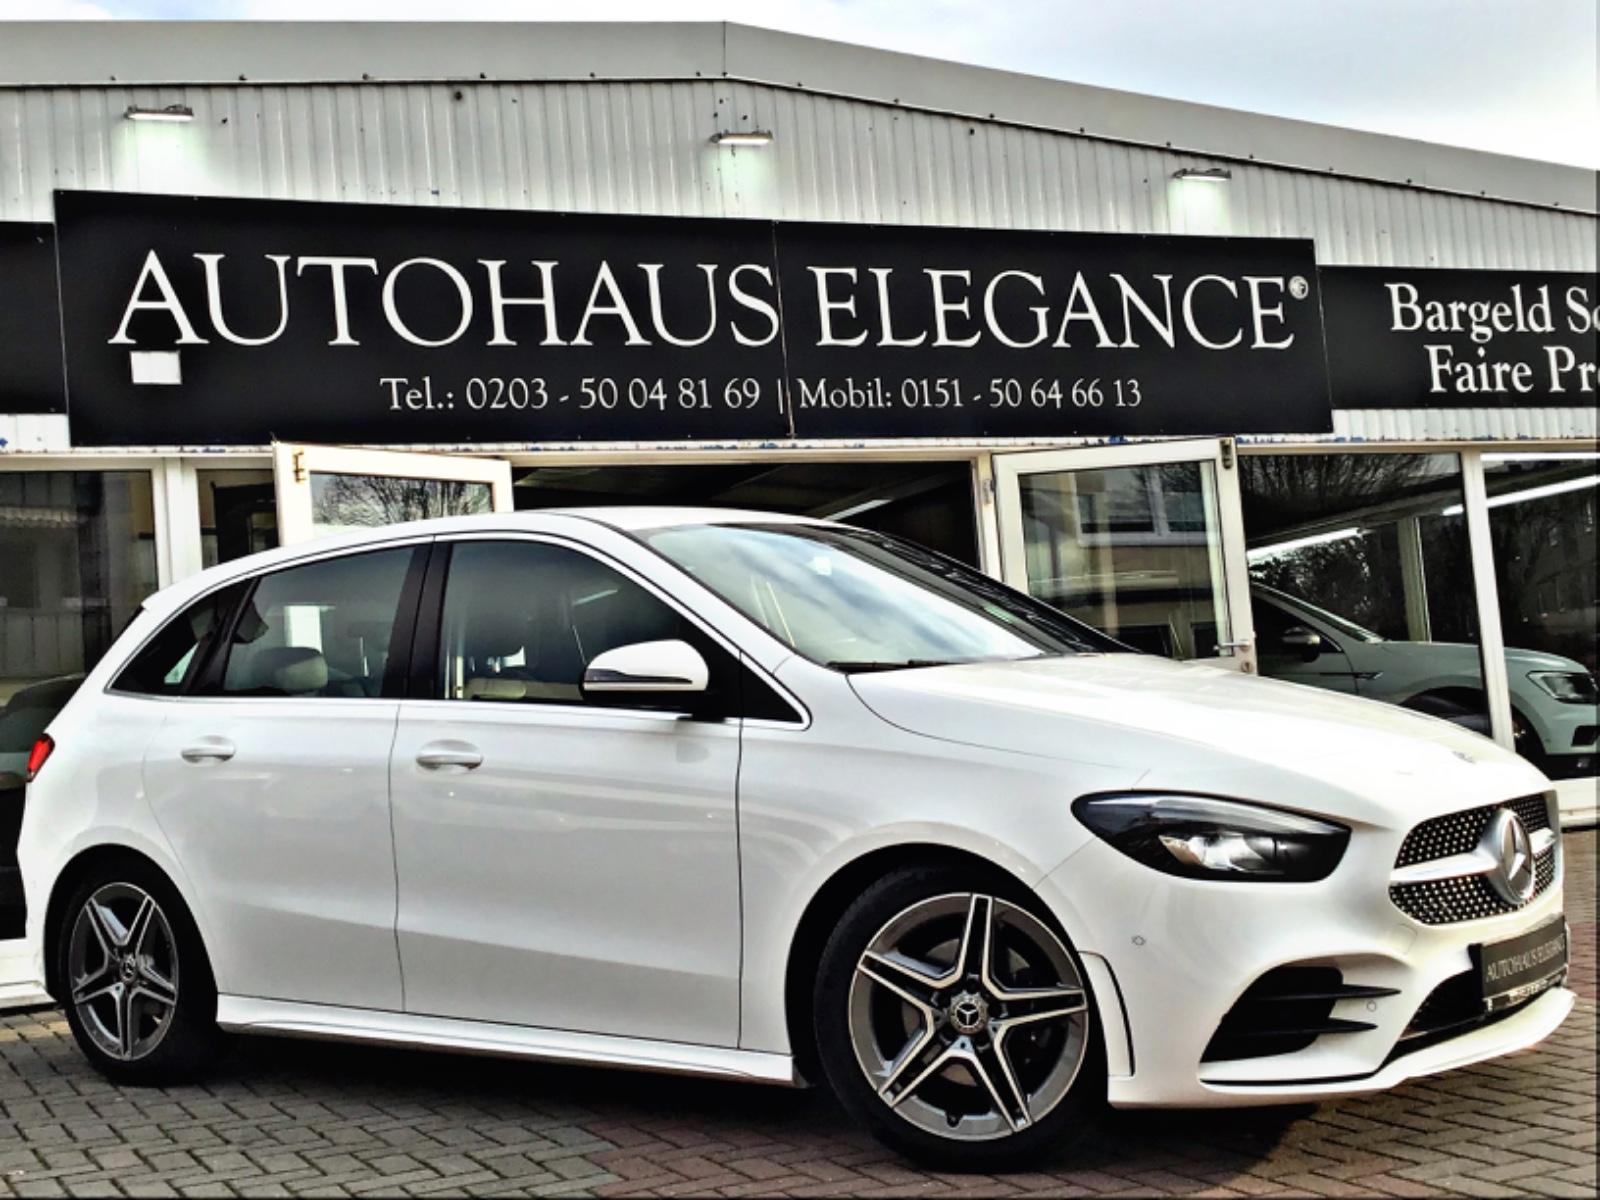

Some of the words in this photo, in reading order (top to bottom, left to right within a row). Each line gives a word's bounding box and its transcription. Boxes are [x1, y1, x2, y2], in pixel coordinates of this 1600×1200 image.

[108, 249, 779, 348] AUTOHAUS
[806, 266, 1294, 350] ELEGANCE
[1384, 282, 1556, 344] Bargeld
[1423, 344, 1534, 393] Faire
[1542, 345, 1600, 393] Pr
[379, 376, 454, 409] Tel.:
[466, 377, 548, 409] 0203
[580, 377, 618, 409] 50
[628, 377, 668, 411] 04
[678, 377, 712, 409] 81
[724, 377, 760, 409] 69
[797, 378, 893, 409] Mobil:
[901, 377, 964, 408] 0151
[990, 378, 1022, 408] 50
[1030, 378, 1063, 409] 64
[1071, 378, 1104, 408] 66
[1113, 379, 1142, 408] 13
[1486, 948, 1538, 983] AUTOHAUS
